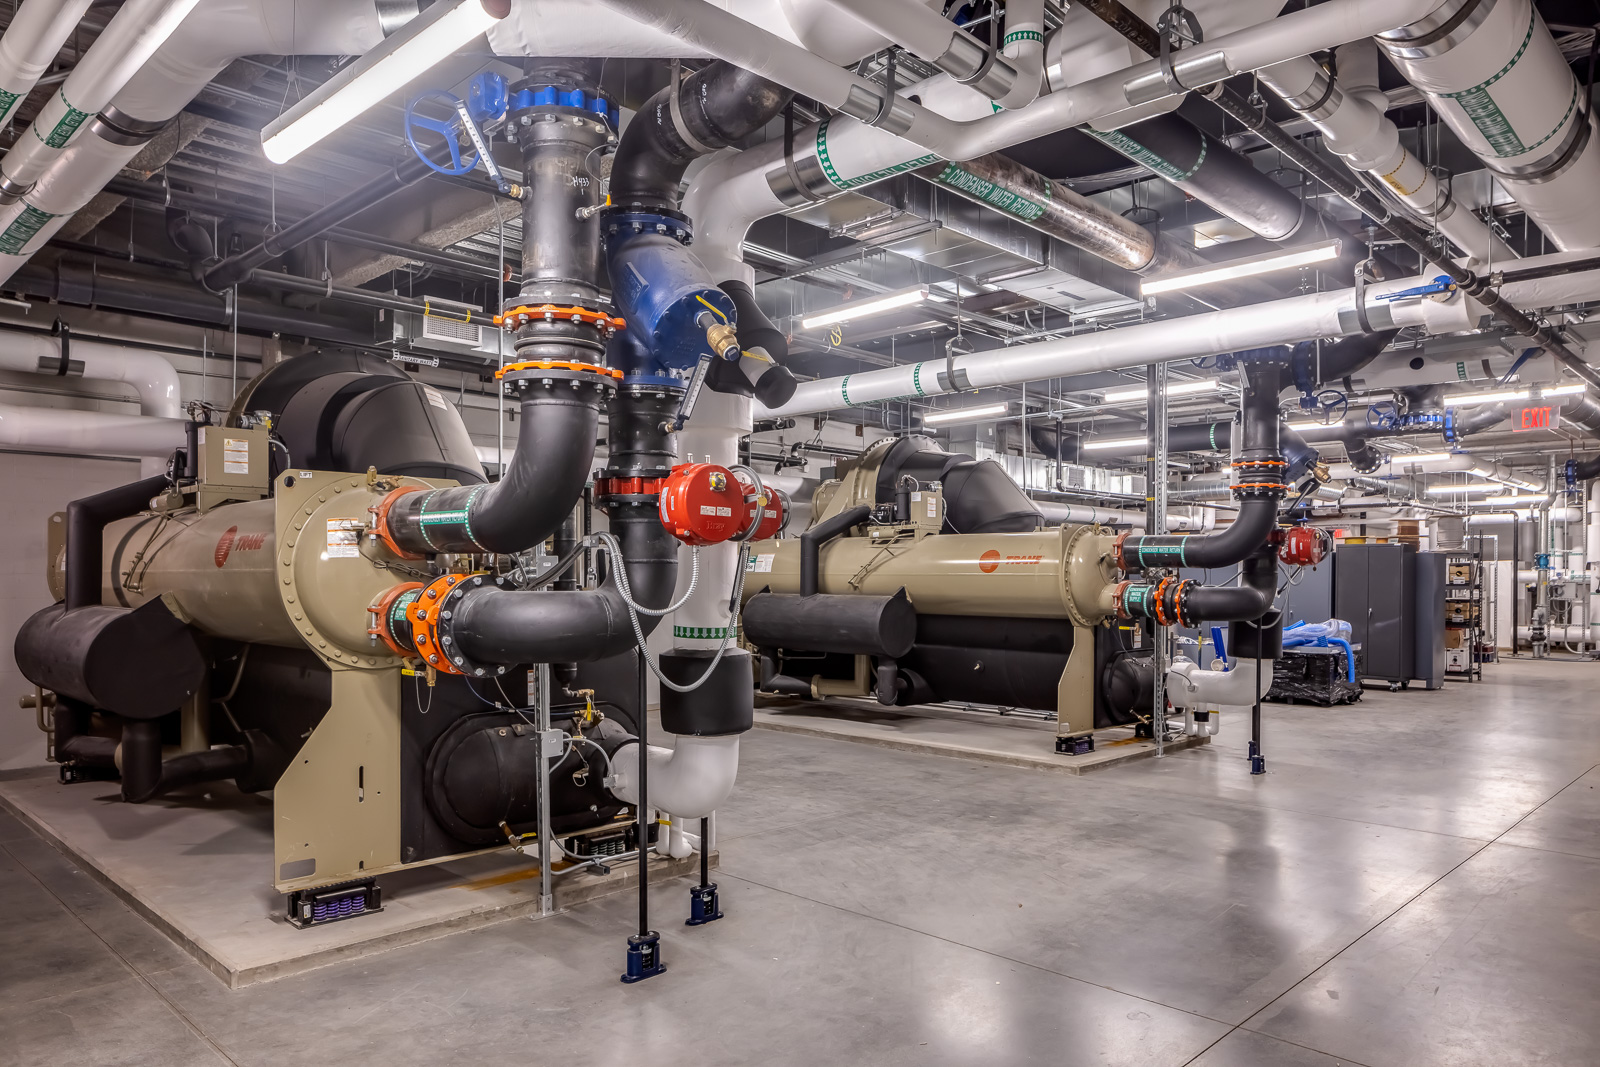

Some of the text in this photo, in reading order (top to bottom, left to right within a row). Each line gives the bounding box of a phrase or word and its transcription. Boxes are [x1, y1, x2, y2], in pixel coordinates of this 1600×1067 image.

[947, 168, 1041, 219] CONDENSER WATER RETURN
[1521, 406, 1552, 429] EXIT
[235, 532, 267, 551] TRANE
[1005, 555, 1043, 565] TRANE
